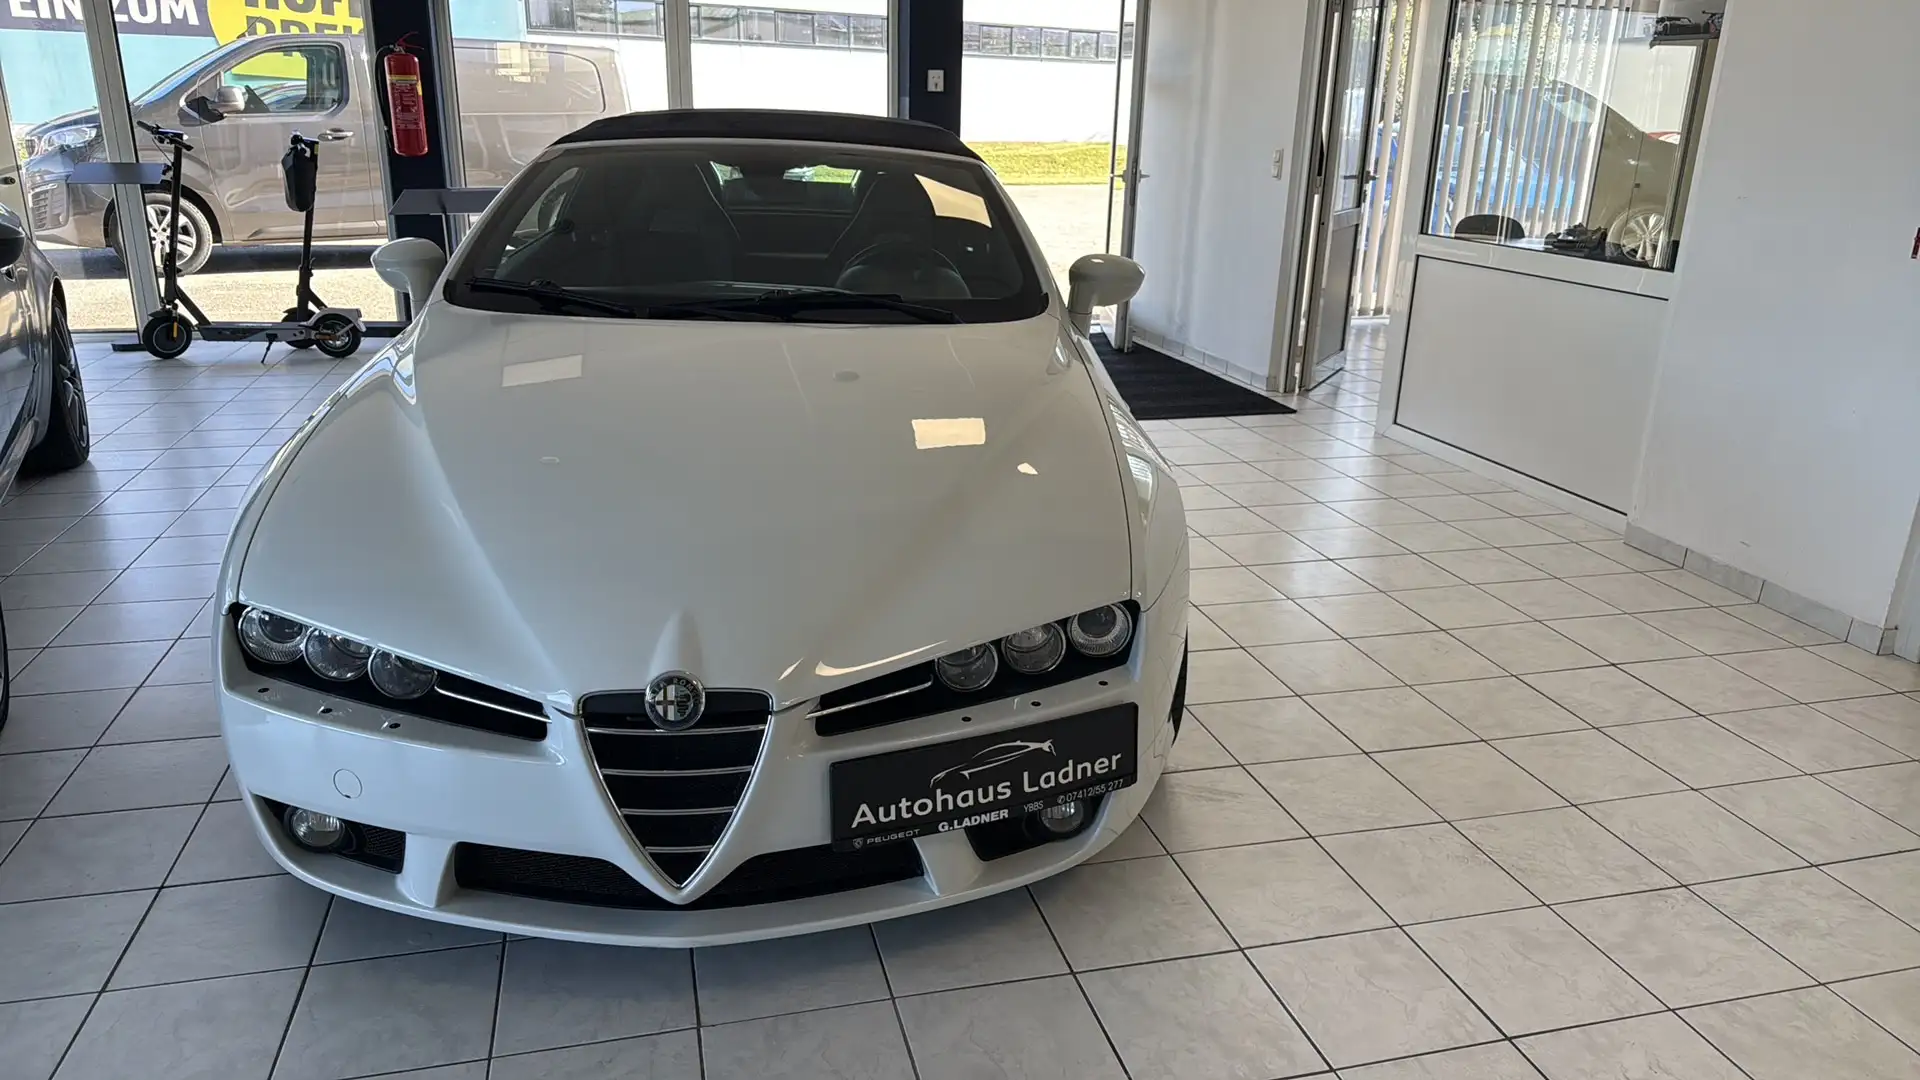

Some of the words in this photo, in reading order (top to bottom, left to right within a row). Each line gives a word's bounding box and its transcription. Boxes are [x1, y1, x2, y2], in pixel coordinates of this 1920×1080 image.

[851, 781, 1012, 829] Autohaus
[1022, 752, 1122, 793] Ladner
[866, 828, 921, 845] PEUGEOT
[937, 808, 1009, 832] G.LADNER
[1023, 800, 1044, 813] YBBS
